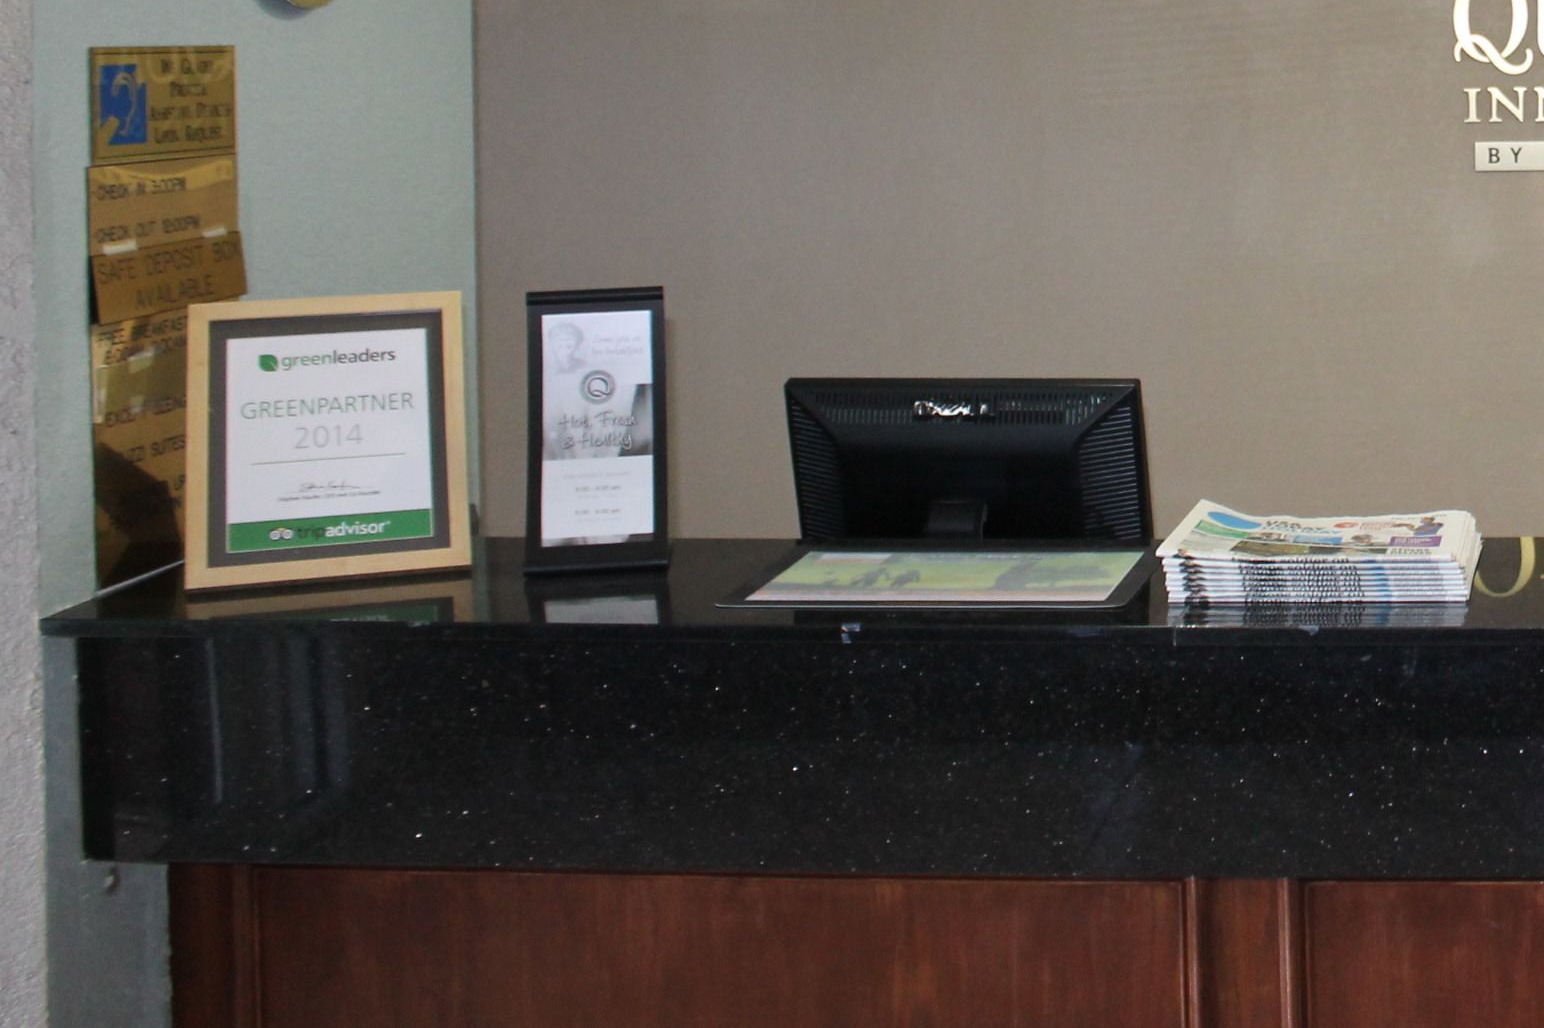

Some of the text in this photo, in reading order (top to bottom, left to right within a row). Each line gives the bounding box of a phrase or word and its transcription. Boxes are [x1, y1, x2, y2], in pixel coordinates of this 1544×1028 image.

[1487, 146, 1523, 164] BY
[281, 348, 396, 371] greenleaders
[240, 392, 414, 420] GREENPARTNER
[294, 424, 363, 449] 2014
